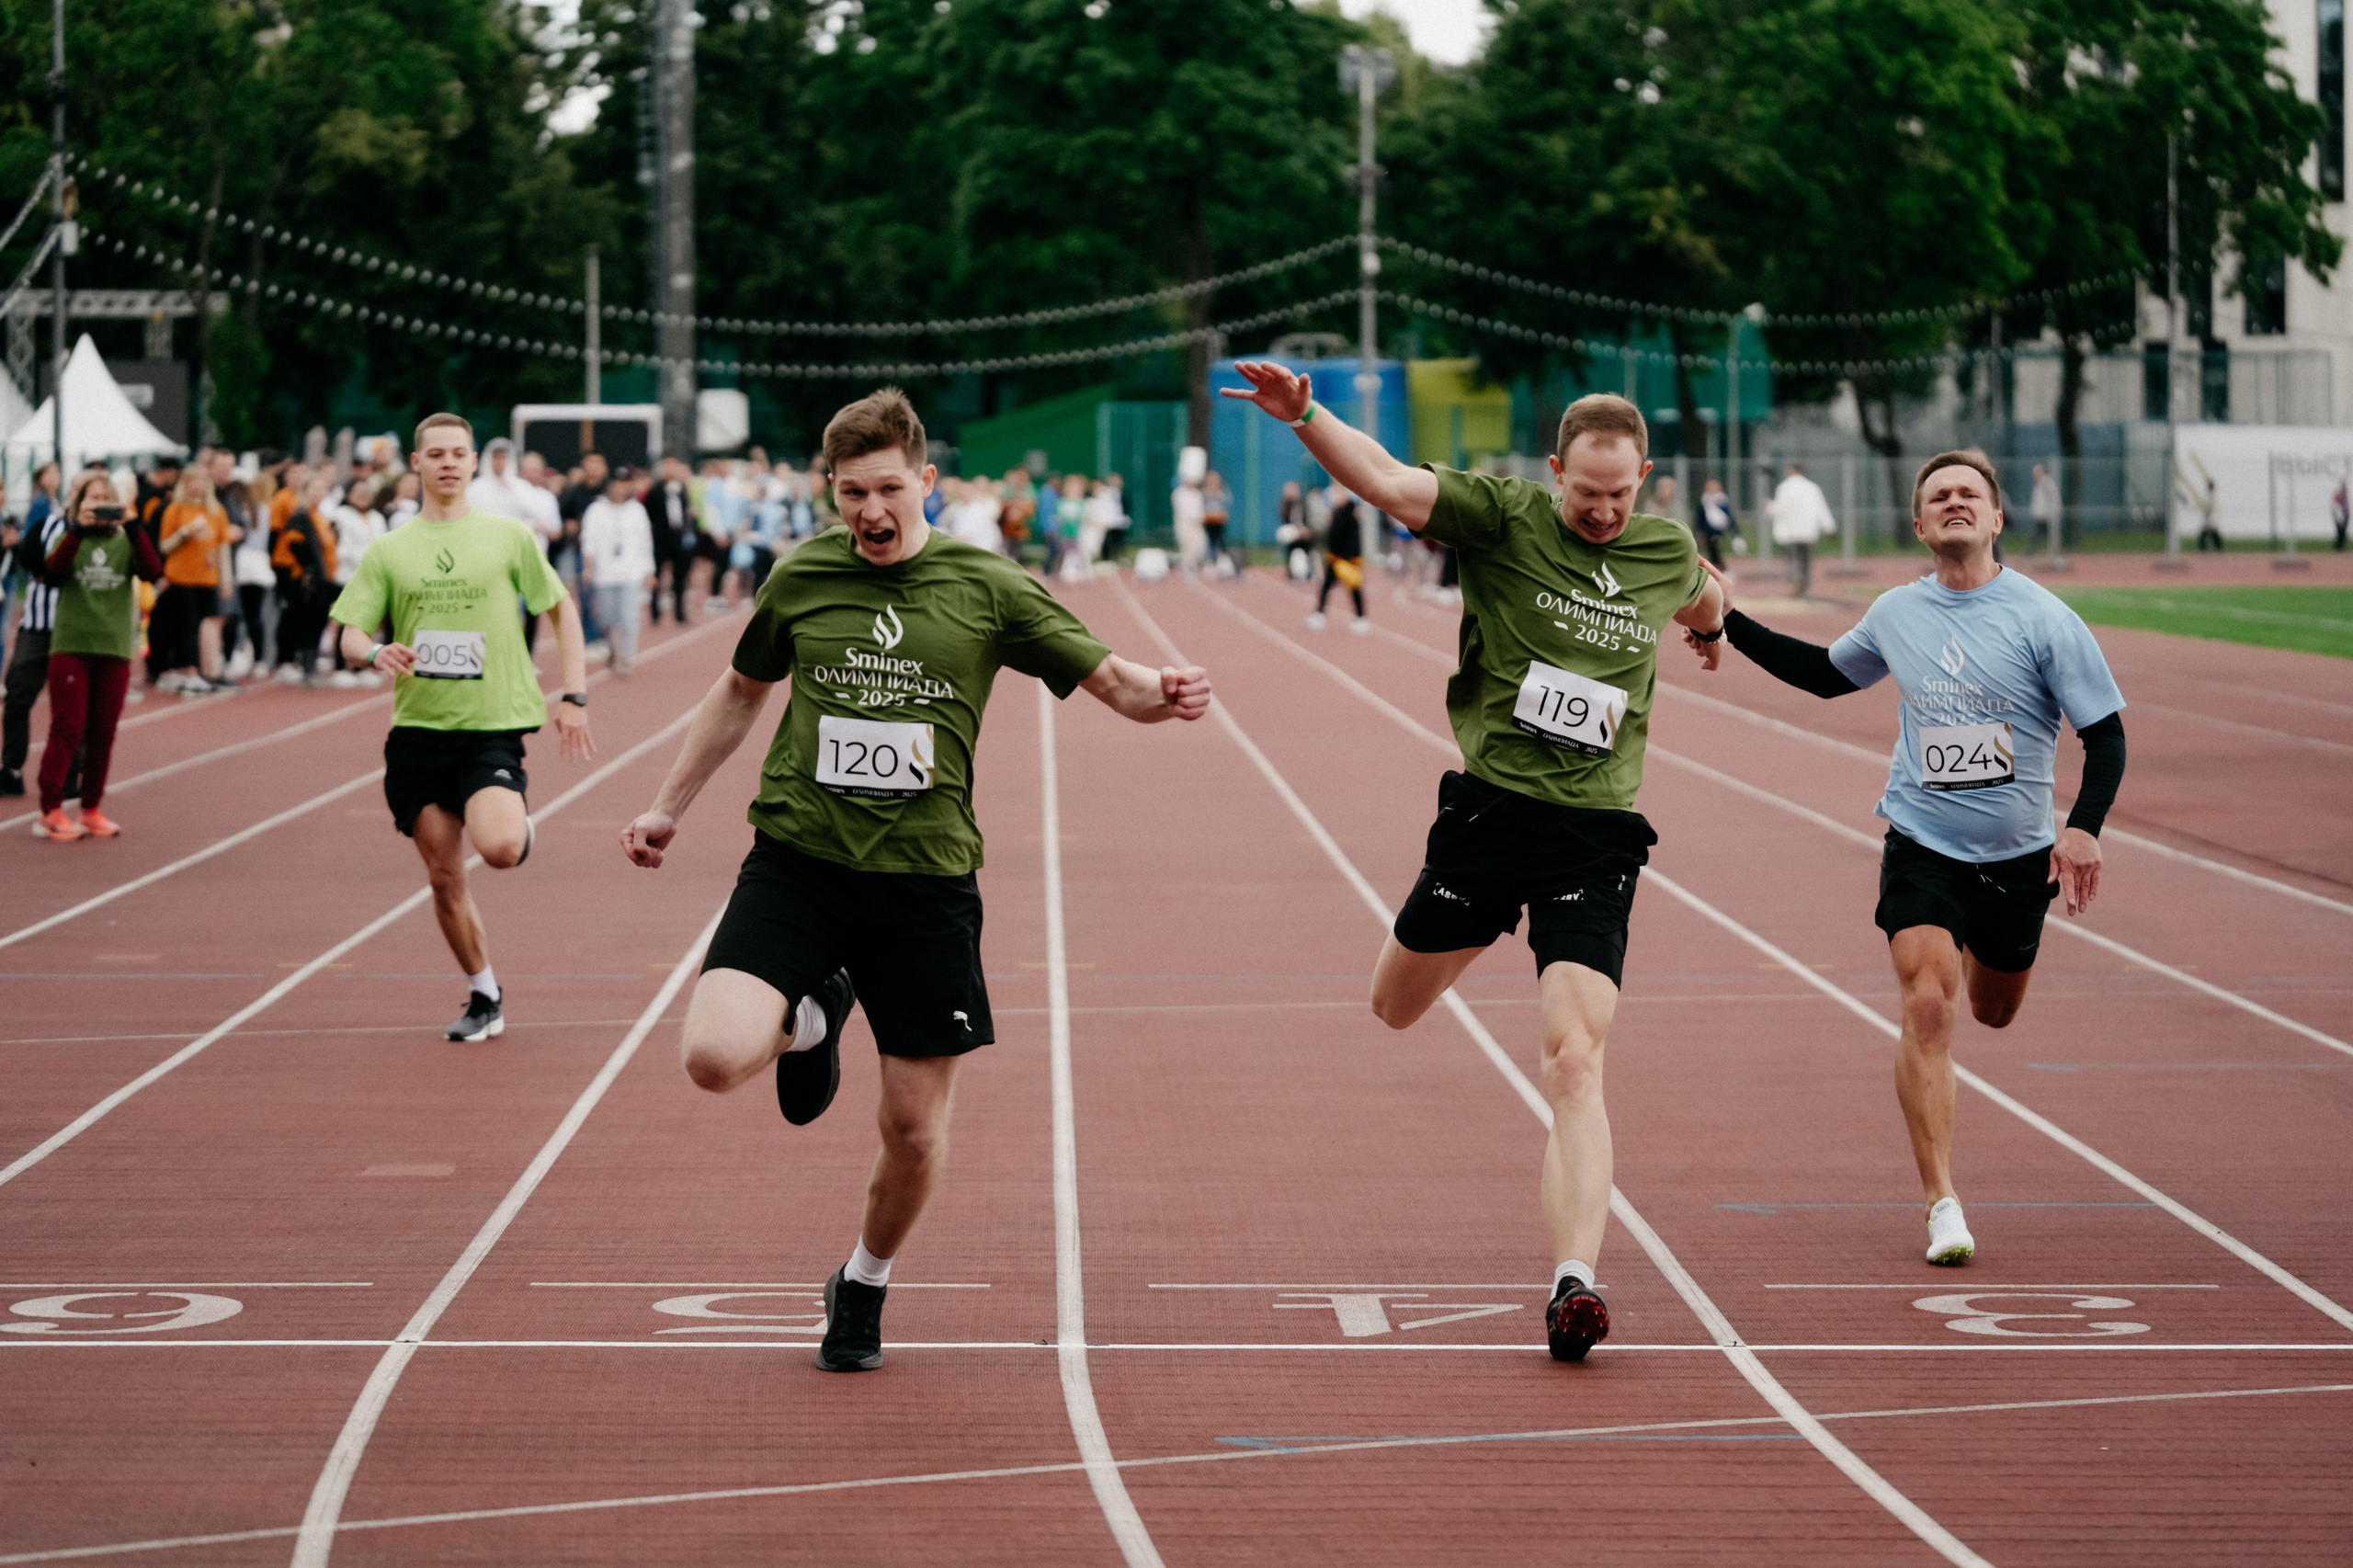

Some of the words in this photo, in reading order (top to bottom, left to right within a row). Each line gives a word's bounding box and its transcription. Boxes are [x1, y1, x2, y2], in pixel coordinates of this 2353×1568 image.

[421, 577, 468, 588] Sminex
[428, 603, 459, 613] 2025
[1571, 588, 1638, 619] Sminex
[1536, 592, 1657, 646] ОЛИМПИАДА
[1574, 624, 1621, 651] 2025
[417, 643, 469, 666] 005
[846, 647, 923, 676] Sminex
[814, 665, 954, 699] ОЛИМПИАДА
[1923, 675, 1984, 696] Sminex
[858, 689, 907, 707] 2025
[1538, 685, 1589, 728] 119
[1937, 712, 1976, 726] 2025
[829, 739, 898, 778] 120
[1926, 743, 1993, 773] 024
[0, 1291, 244, 1334] 6
[1272, 1293, 1524, 1336] 4
[1912, 1292, 2152, 1336] 3
